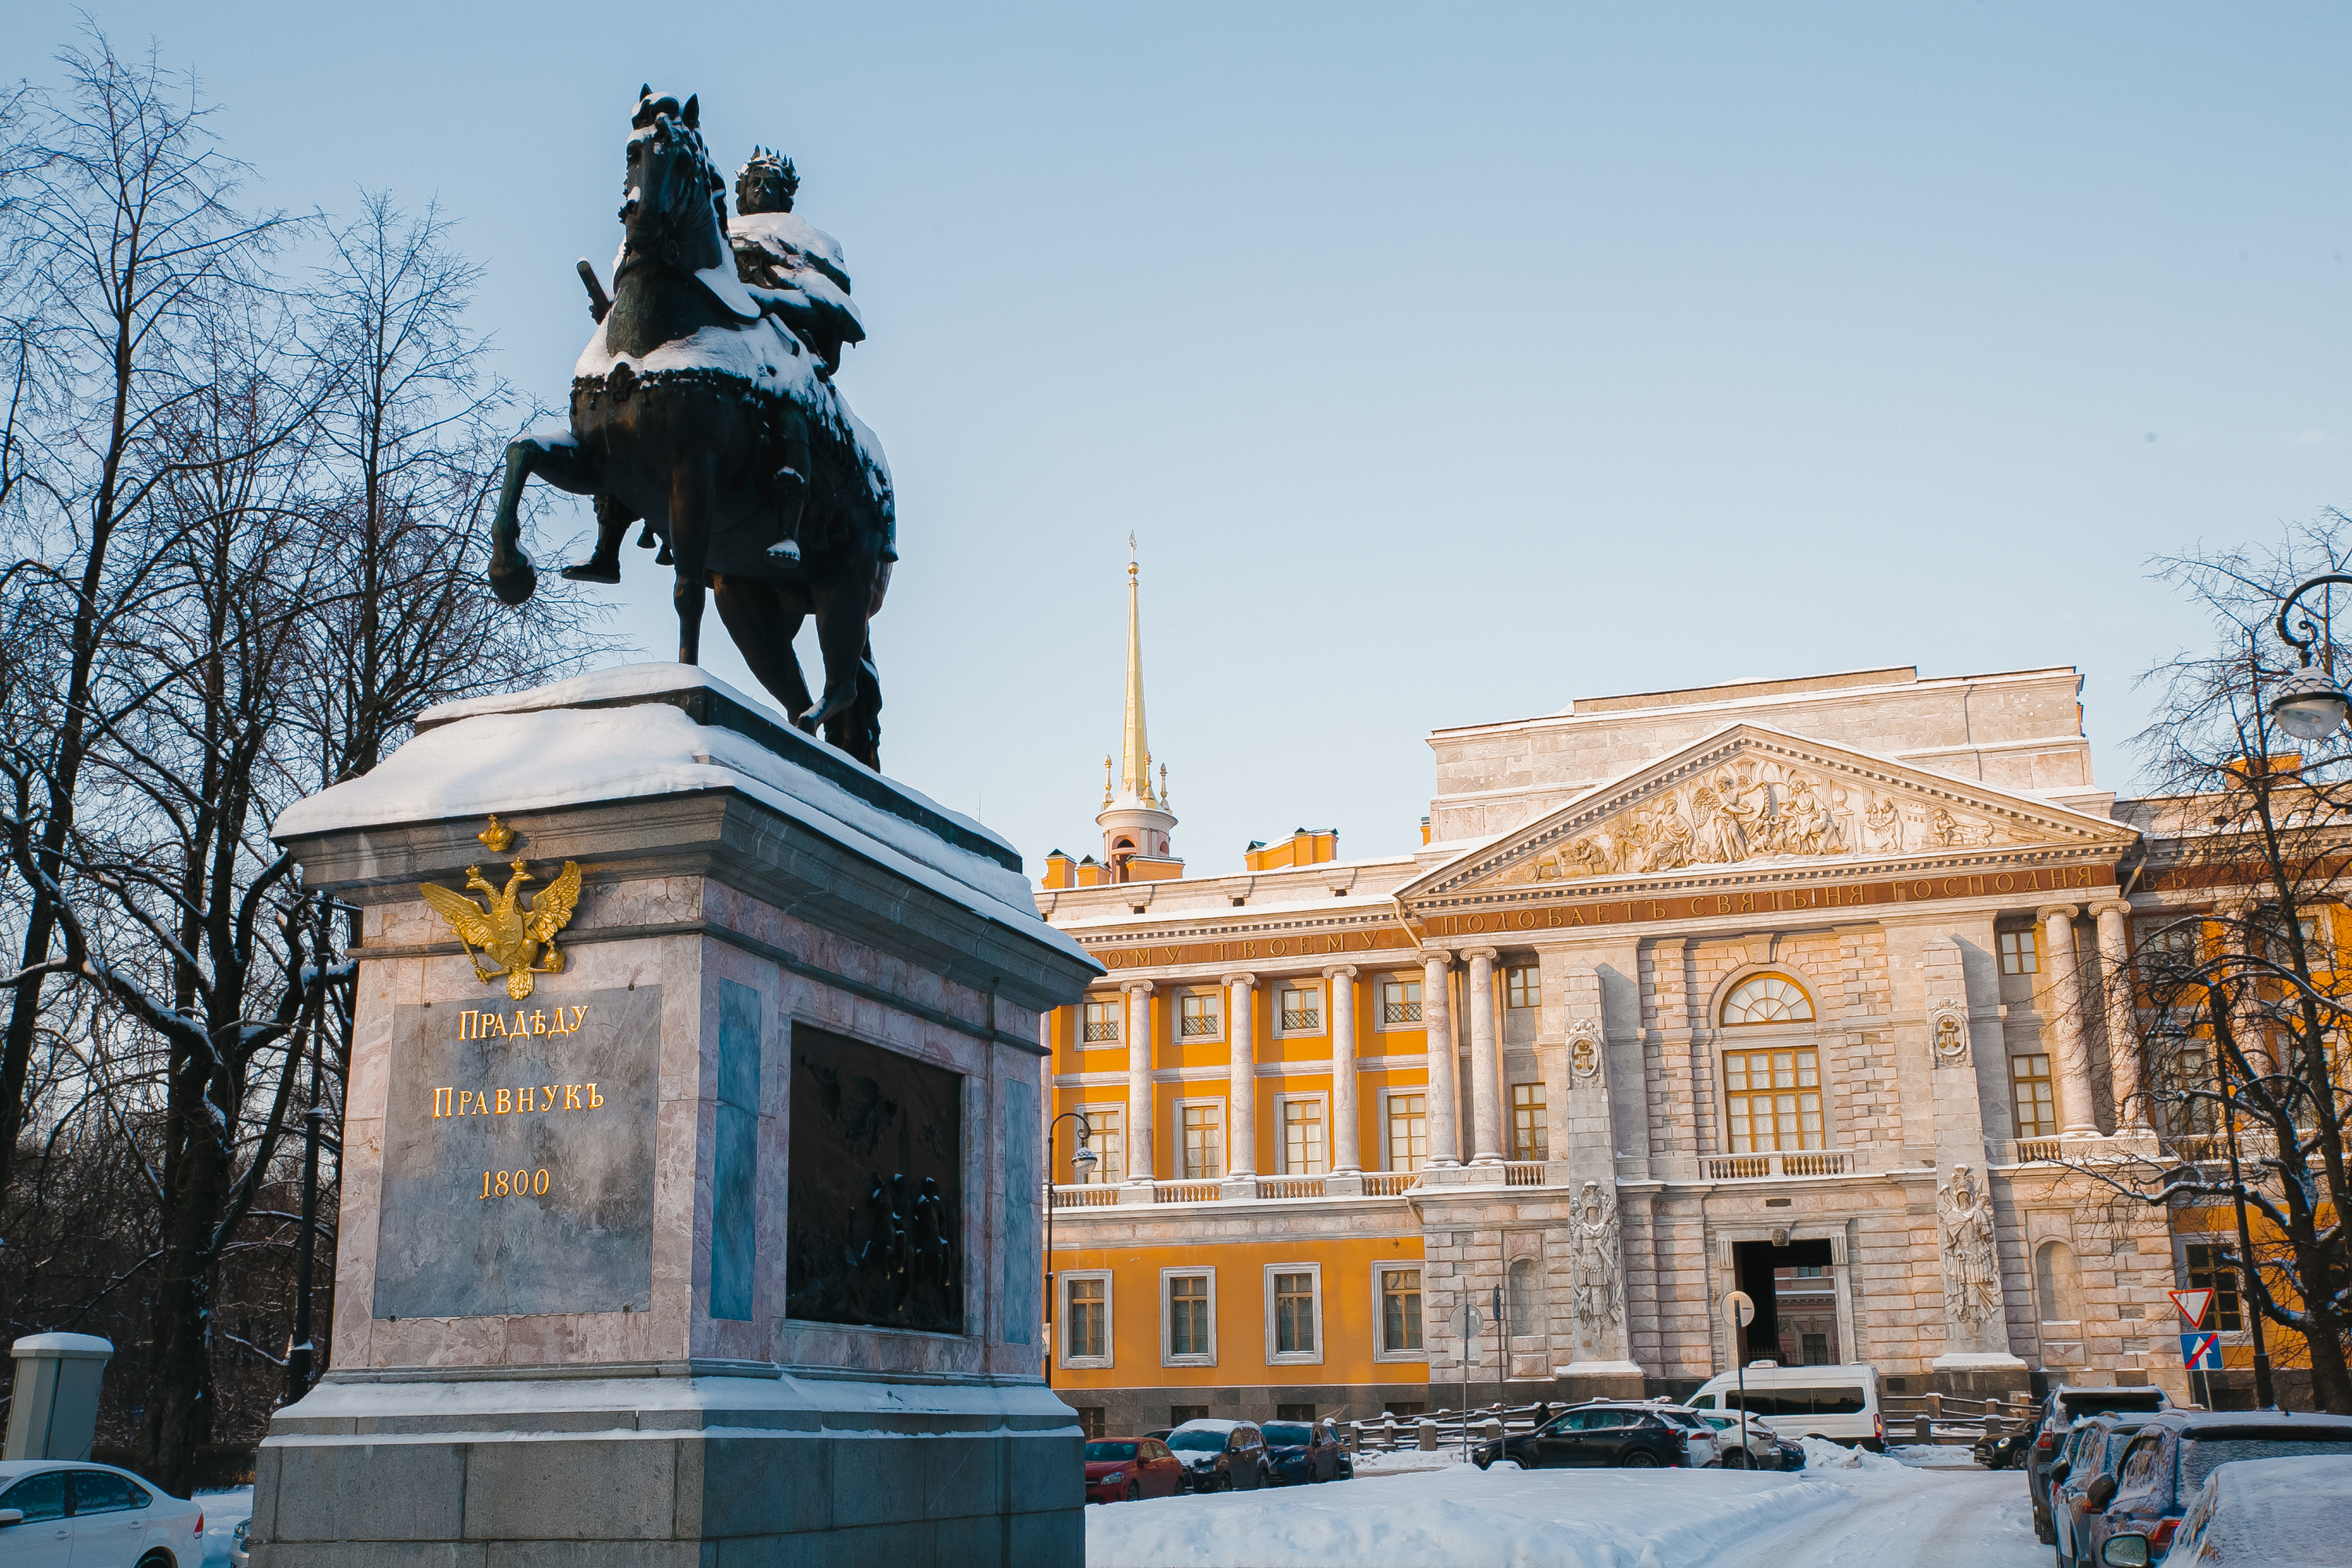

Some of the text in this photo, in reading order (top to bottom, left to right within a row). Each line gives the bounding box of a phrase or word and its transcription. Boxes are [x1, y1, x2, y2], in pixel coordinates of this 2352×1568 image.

[2141, 869, 2187, 891] ВЪ
[1443, 866, 2093, 935] ПОДОБАЕТЪ СВЯТЫНЯ ГОСПОДНЯ
[1088, 931, 1378, 968] ОМУ ТВОЕМУ
[433, 1083, 604, 1119] ПРАВНУКЪ
[478, 1168, 550, 1200] 1800
